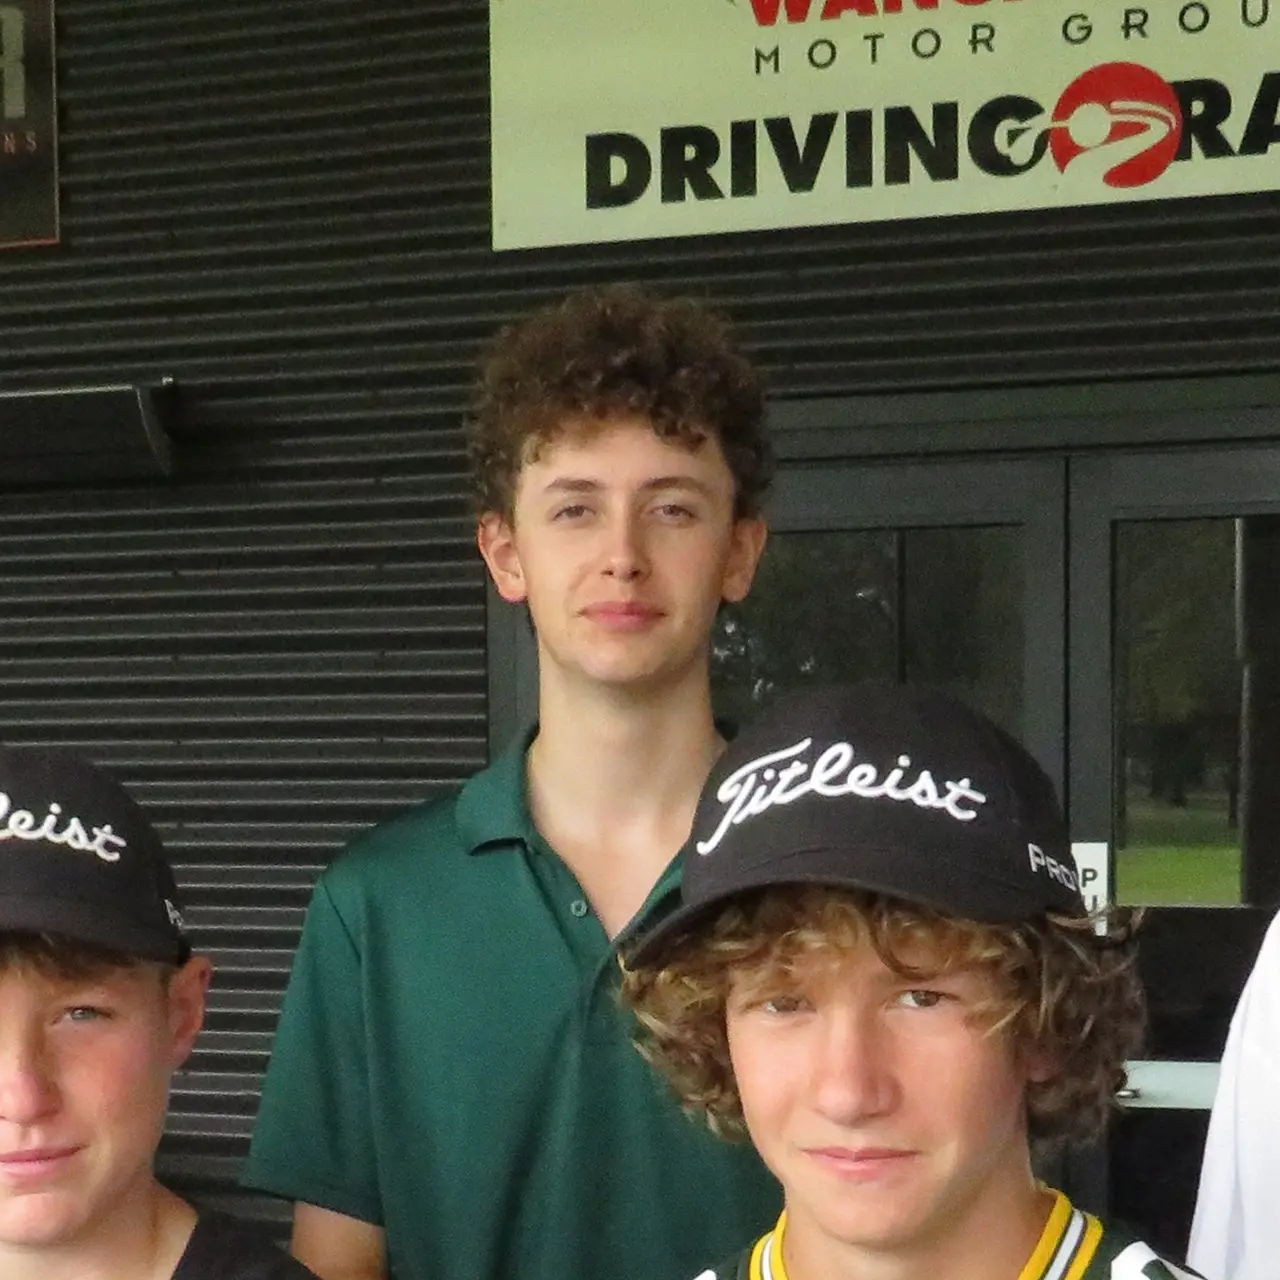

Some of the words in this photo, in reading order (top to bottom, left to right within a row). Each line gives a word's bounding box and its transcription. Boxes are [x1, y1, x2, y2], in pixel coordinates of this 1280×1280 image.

[754, 22, 996, 76] MOTOR
[585, 94, 1052, 210] DRIVING
[696, 737, 987, 856] Titleist
